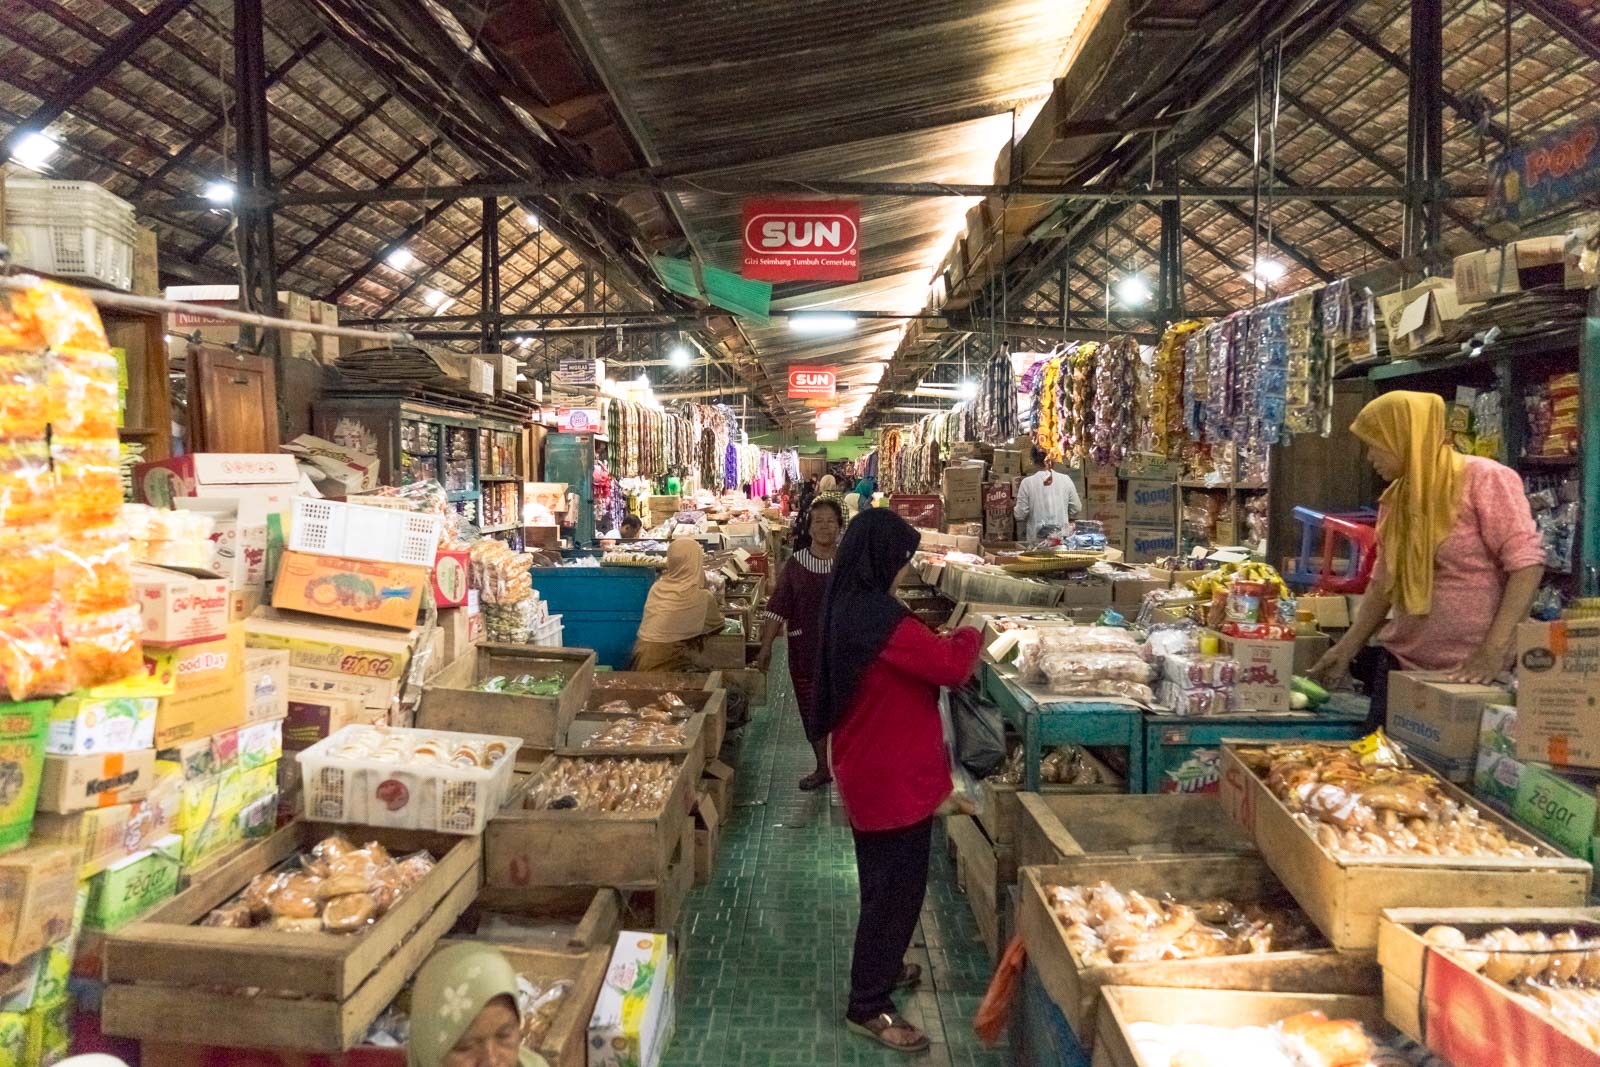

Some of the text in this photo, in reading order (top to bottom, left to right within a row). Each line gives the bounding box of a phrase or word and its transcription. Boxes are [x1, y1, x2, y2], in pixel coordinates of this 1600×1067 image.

[762, 221, 840, 248] SUN
[821, 258, 856, 267] Cemerlang
[796, 374, 829, 386] SUN
[986, 491, 1007, 502] Fullo
[1393, 714, 1441, 742] mentos
